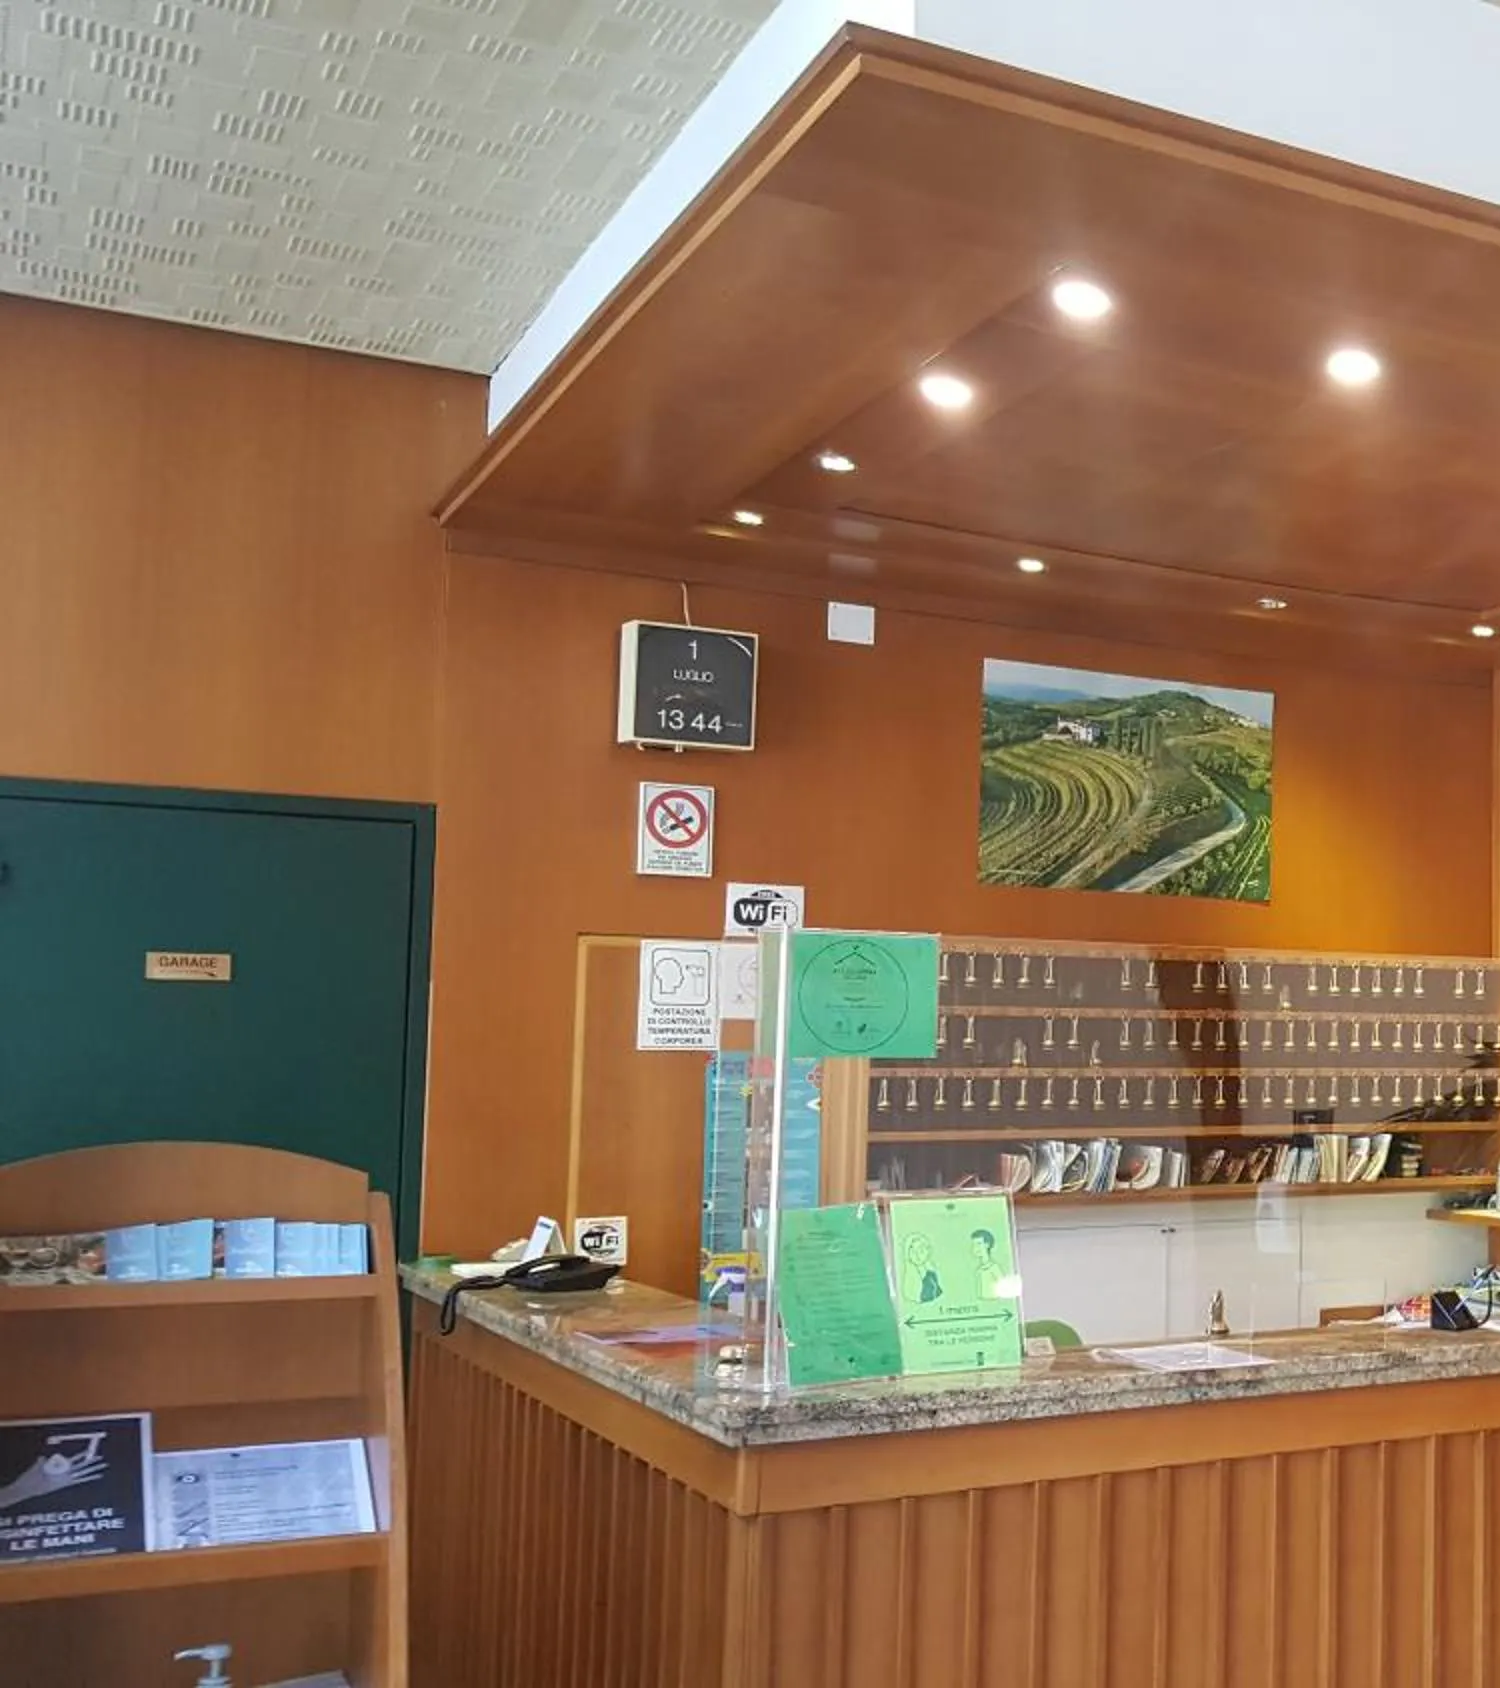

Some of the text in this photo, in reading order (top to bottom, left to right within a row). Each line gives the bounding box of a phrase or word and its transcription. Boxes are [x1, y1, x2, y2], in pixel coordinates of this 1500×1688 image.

[687, 639, 698, 661] 1
[672, 668, 715, 683] LUGLIO
[656, 708, 723, 734] 13 44
[158, 955, 218, 969] GARAGE
[652, 1007, 705, 1017] POSTAZIONE
[647, 1017, 712, 1026] DI CONTROLLO
[647, 1027, 711, 1035] TEMPERATURA
[16, 1509, 89, 1526] PREGA
[91, 1507, 114, 1519] DI
[9, 1532, 95, 1551] LE MANI
